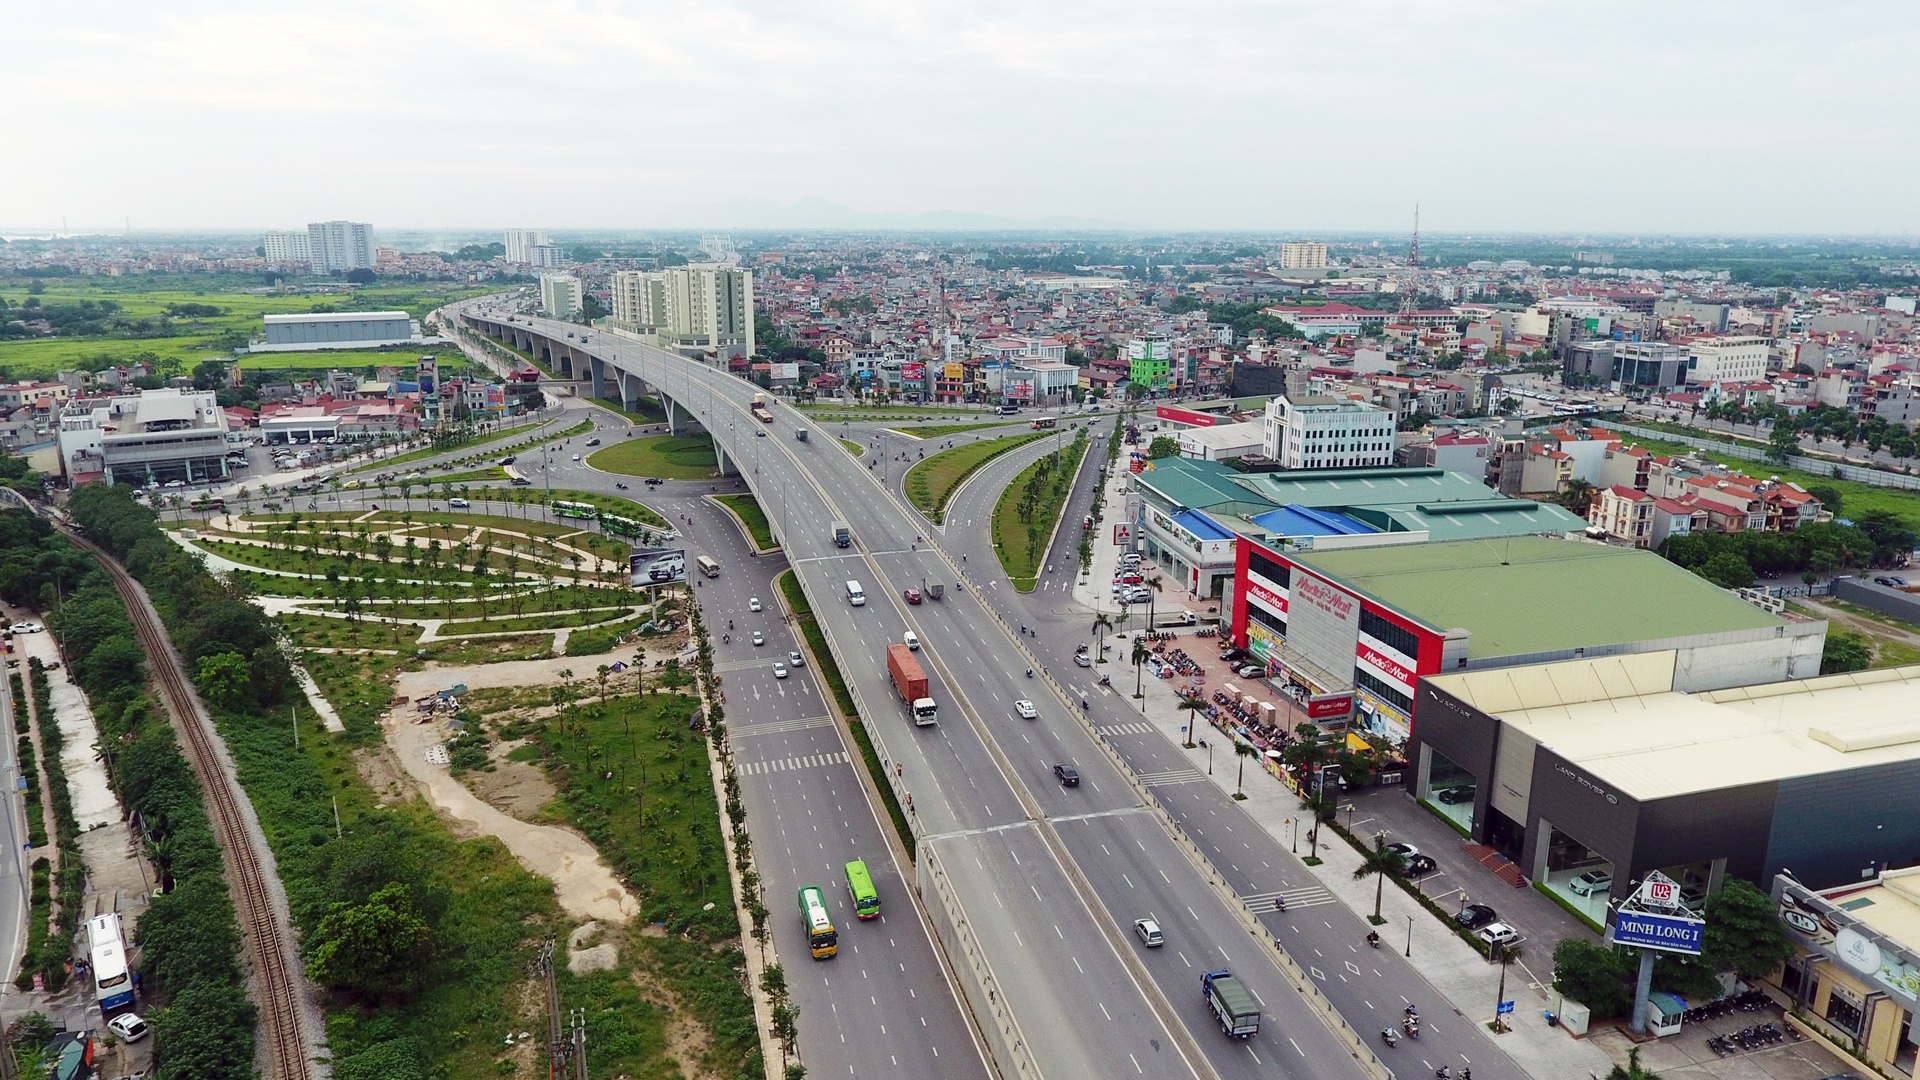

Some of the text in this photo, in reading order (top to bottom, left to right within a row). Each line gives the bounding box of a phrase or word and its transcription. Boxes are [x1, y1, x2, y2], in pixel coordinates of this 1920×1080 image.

[1439, 699, 1471, 719] JAGUAR
[1555, 763, 1605, 797] LAND ROVER
[1621, 921, 1654, 936] MINH
[1656, 925, 1690, 940] LONG
